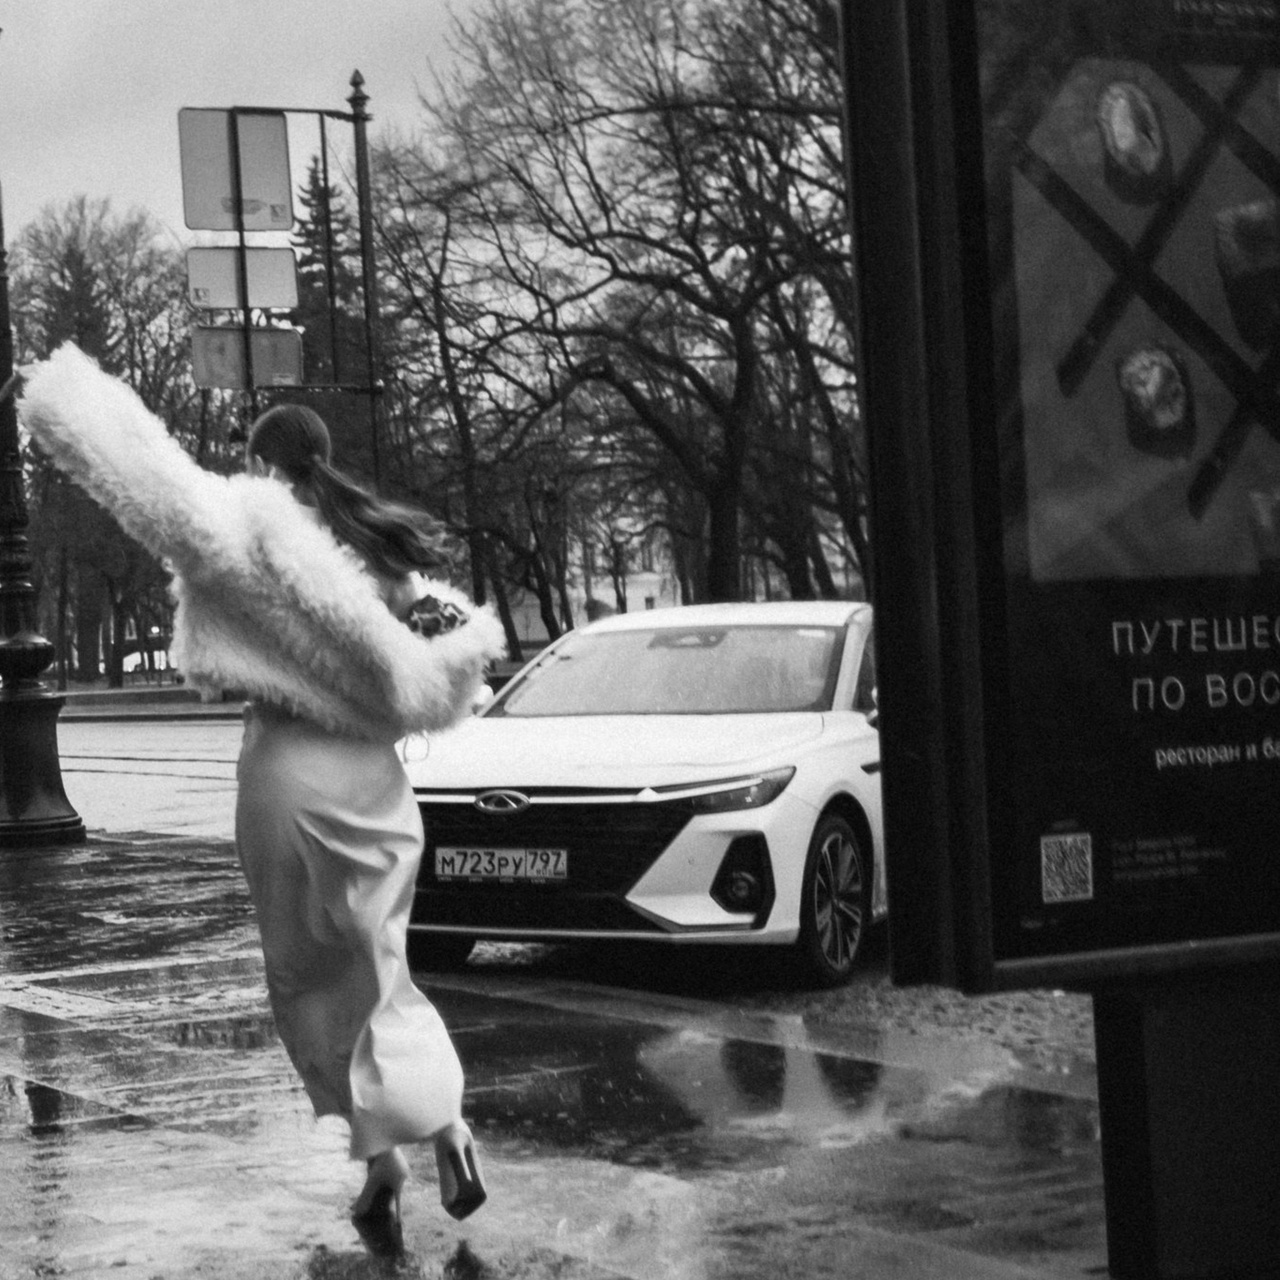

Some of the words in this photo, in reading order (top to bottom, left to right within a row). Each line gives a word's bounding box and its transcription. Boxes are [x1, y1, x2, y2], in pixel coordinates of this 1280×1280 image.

[1112, 615, 1280, 654] ПУТЕШЕ
[1132, 676, 1185, 711] ПО
[1206, 672, 1280, 708] ВОС
[1155, 744, 1240, 770] ресторан
[1246, 743, 1258, 760] и
